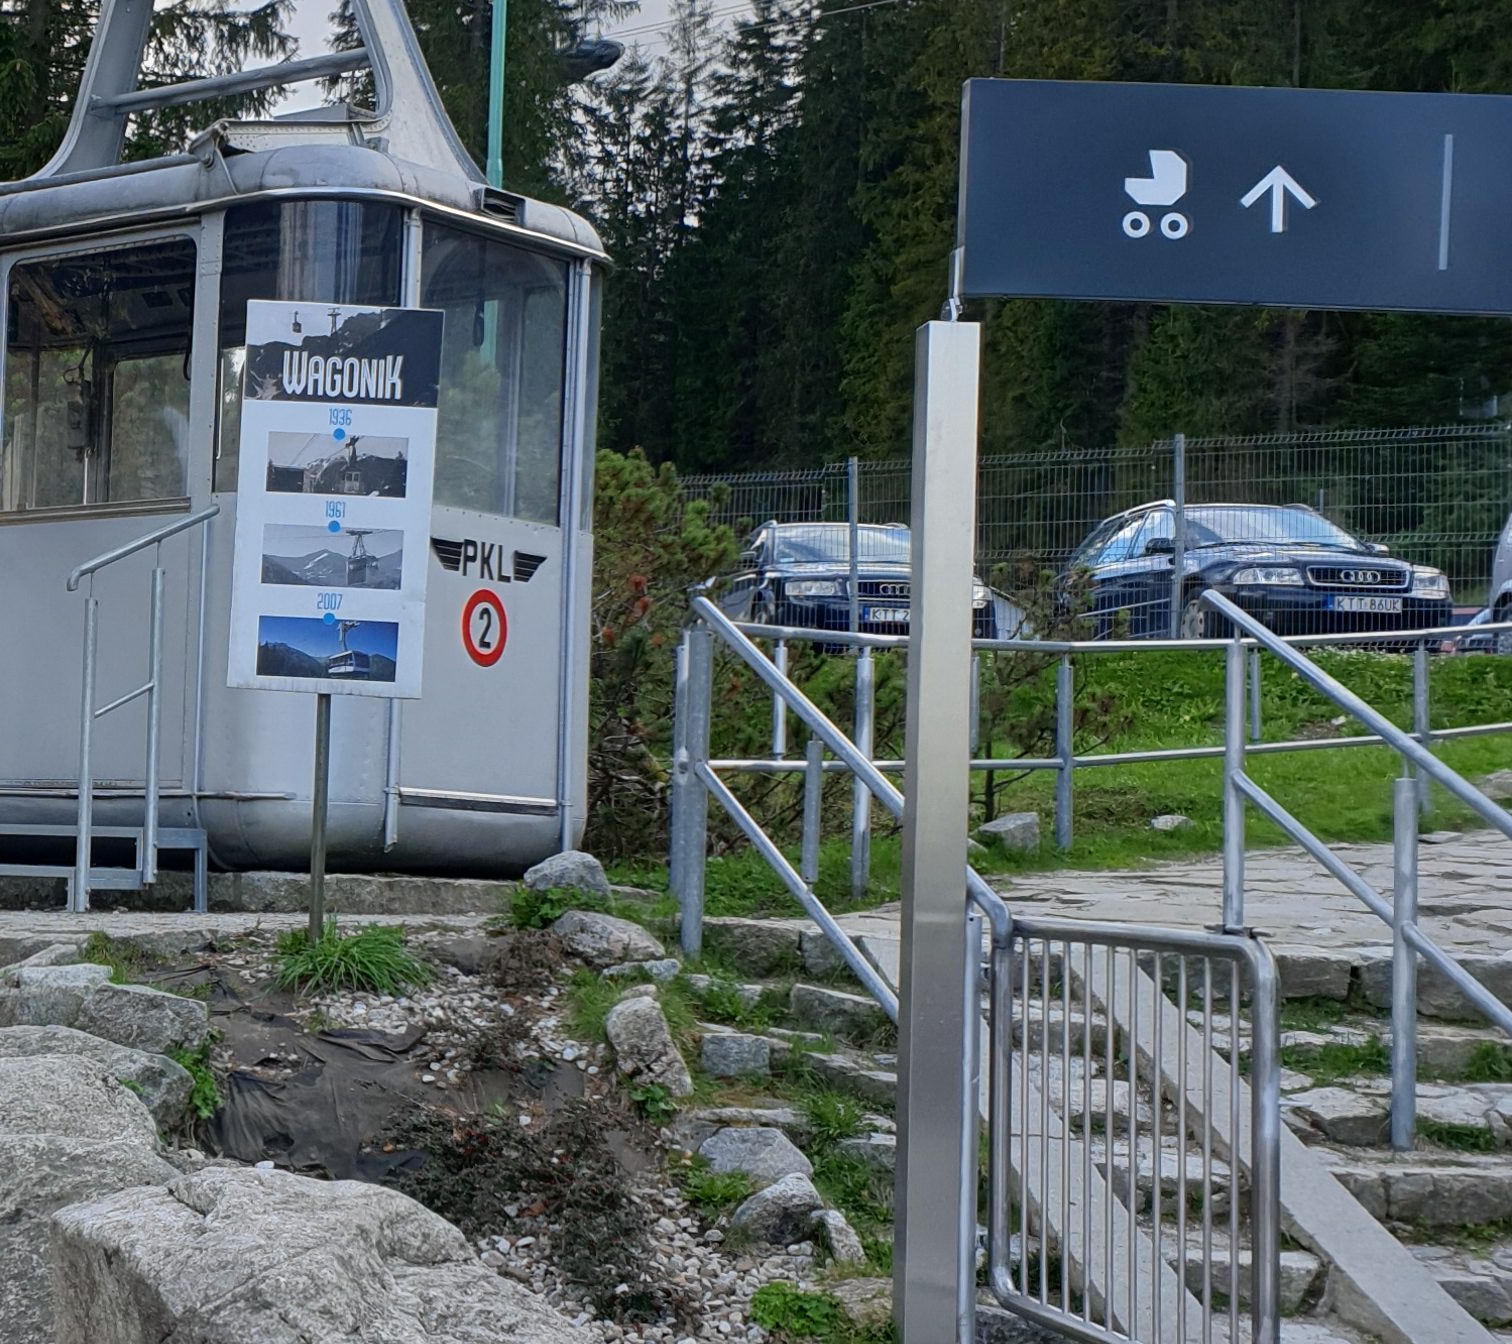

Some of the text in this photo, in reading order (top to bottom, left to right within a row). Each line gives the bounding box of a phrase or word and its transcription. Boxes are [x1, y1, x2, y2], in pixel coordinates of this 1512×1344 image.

[282, 350, 404, 400] WAGONIK
[328, 408, 352, 426] 1936
[325, 500, 346, 519] 1961
[462, 538, 511, 583] PKL
[317, 592, 343, 611] 2007
[1336, 598, 1400, 612] KTT 86UK
[872, 609, 898, 622] KTT
[478, 607, 492, 649] 2
